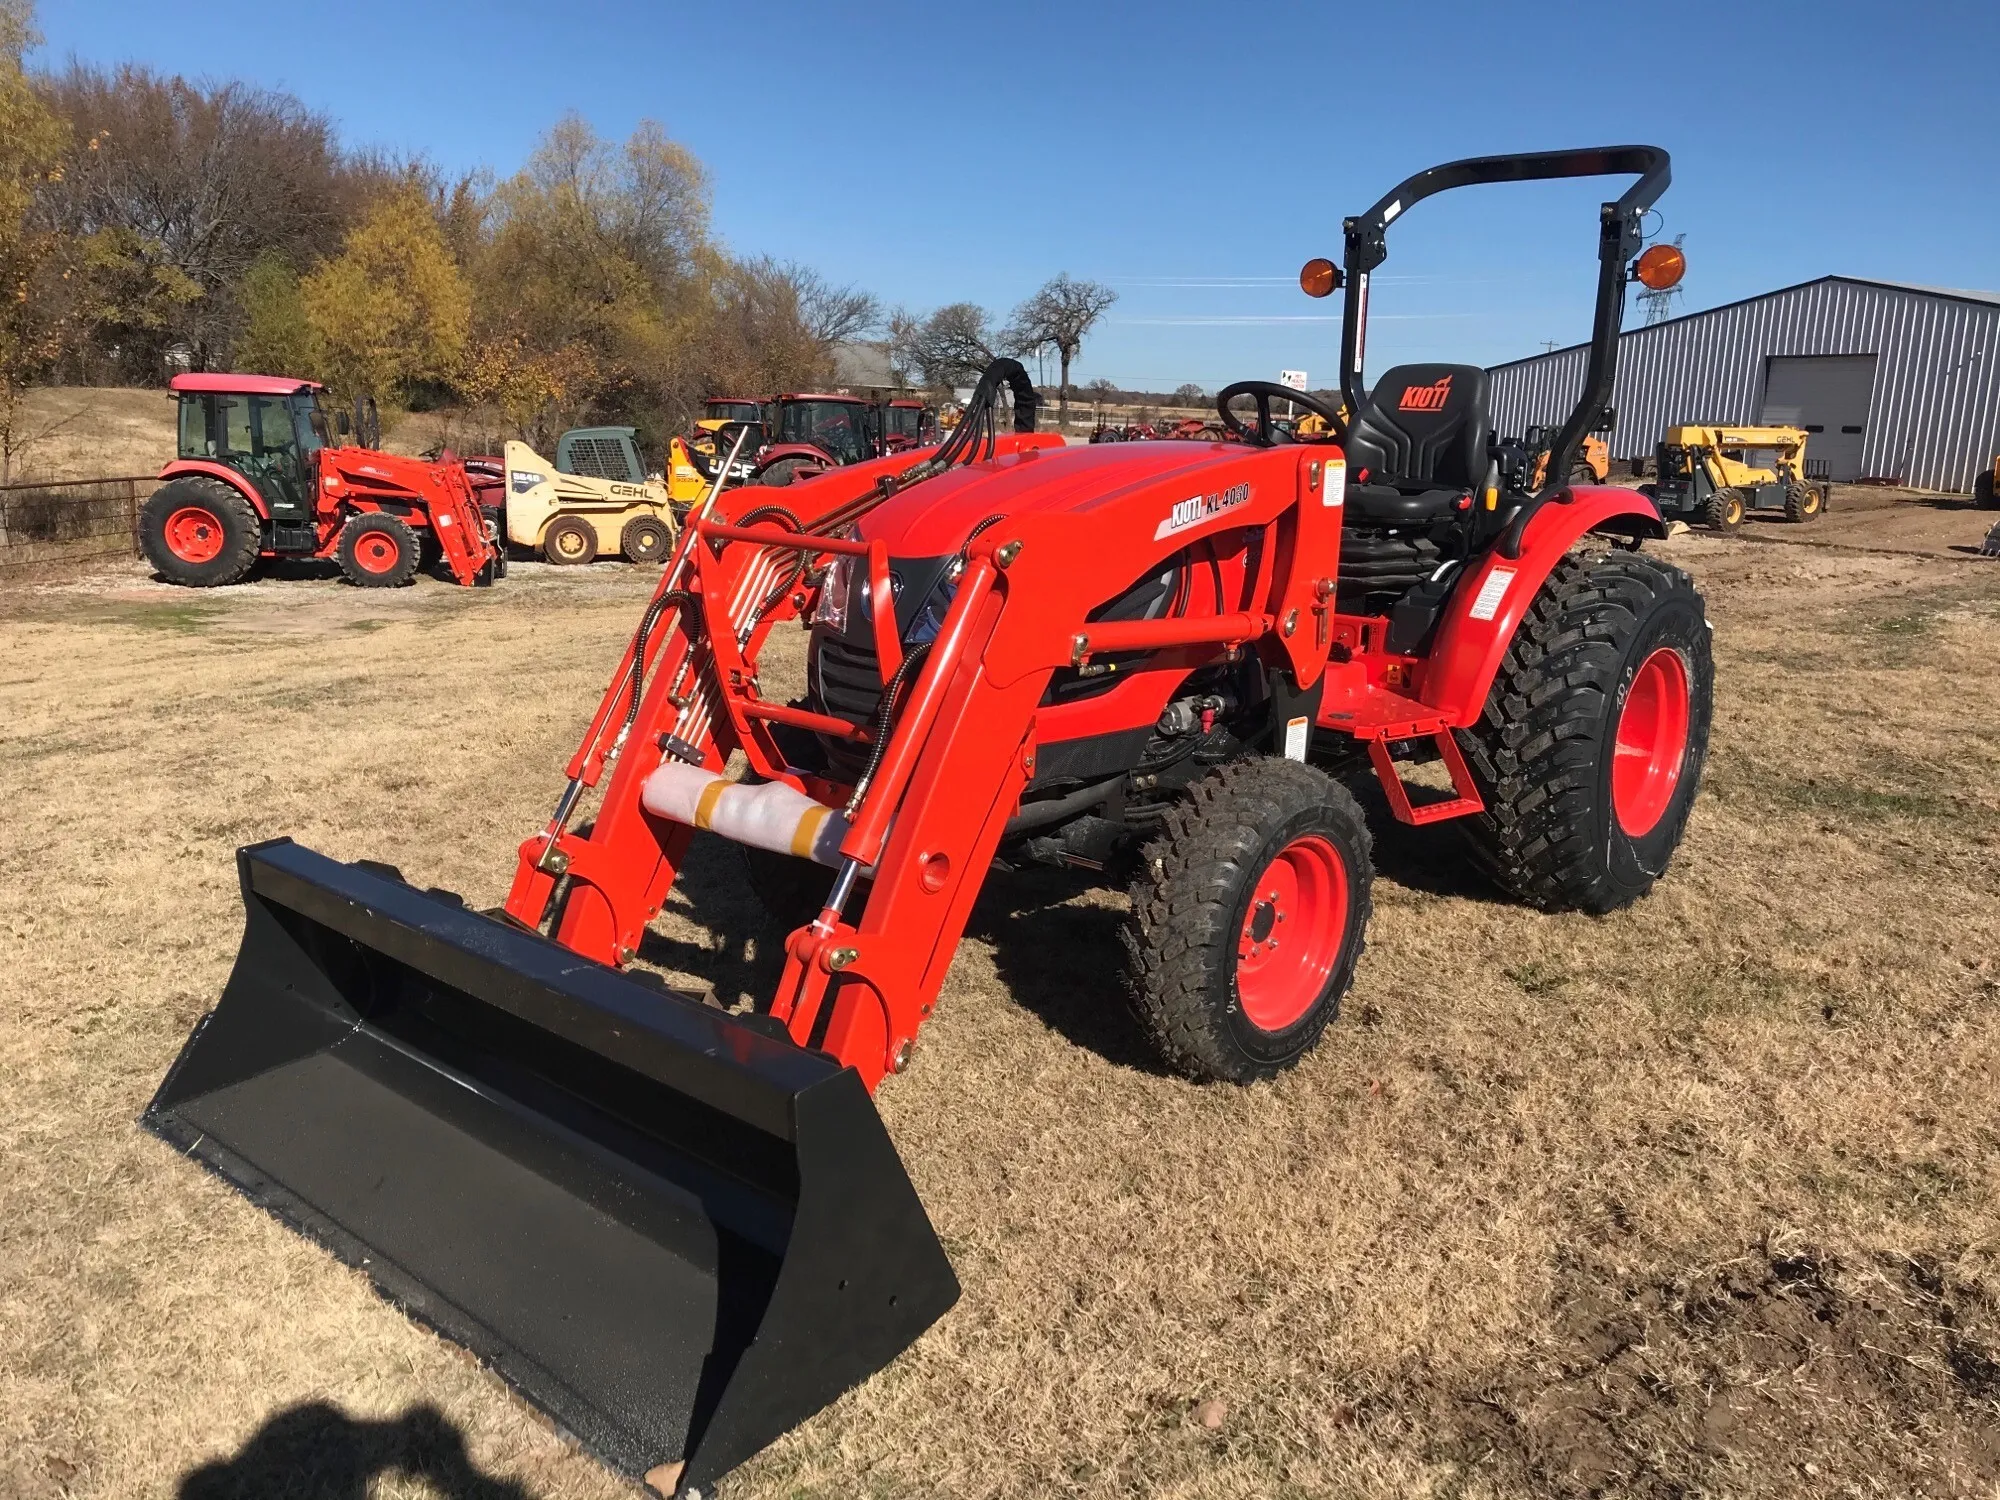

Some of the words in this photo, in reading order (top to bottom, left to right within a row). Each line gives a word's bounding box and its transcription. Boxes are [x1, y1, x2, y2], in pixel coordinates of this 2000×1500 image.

[1400, 386, 1450, 408] KIOTI
[1776, 435, 1796, 443] GEHL
[610, 484, 654, 499] GEHL
[1171, 493, 1203, 529] KIOTI
[1206, 492, 1220, 515] KL
[1221, 481, 1250, 509] 4030
[1658, 498, 1679, 506] GEHL
